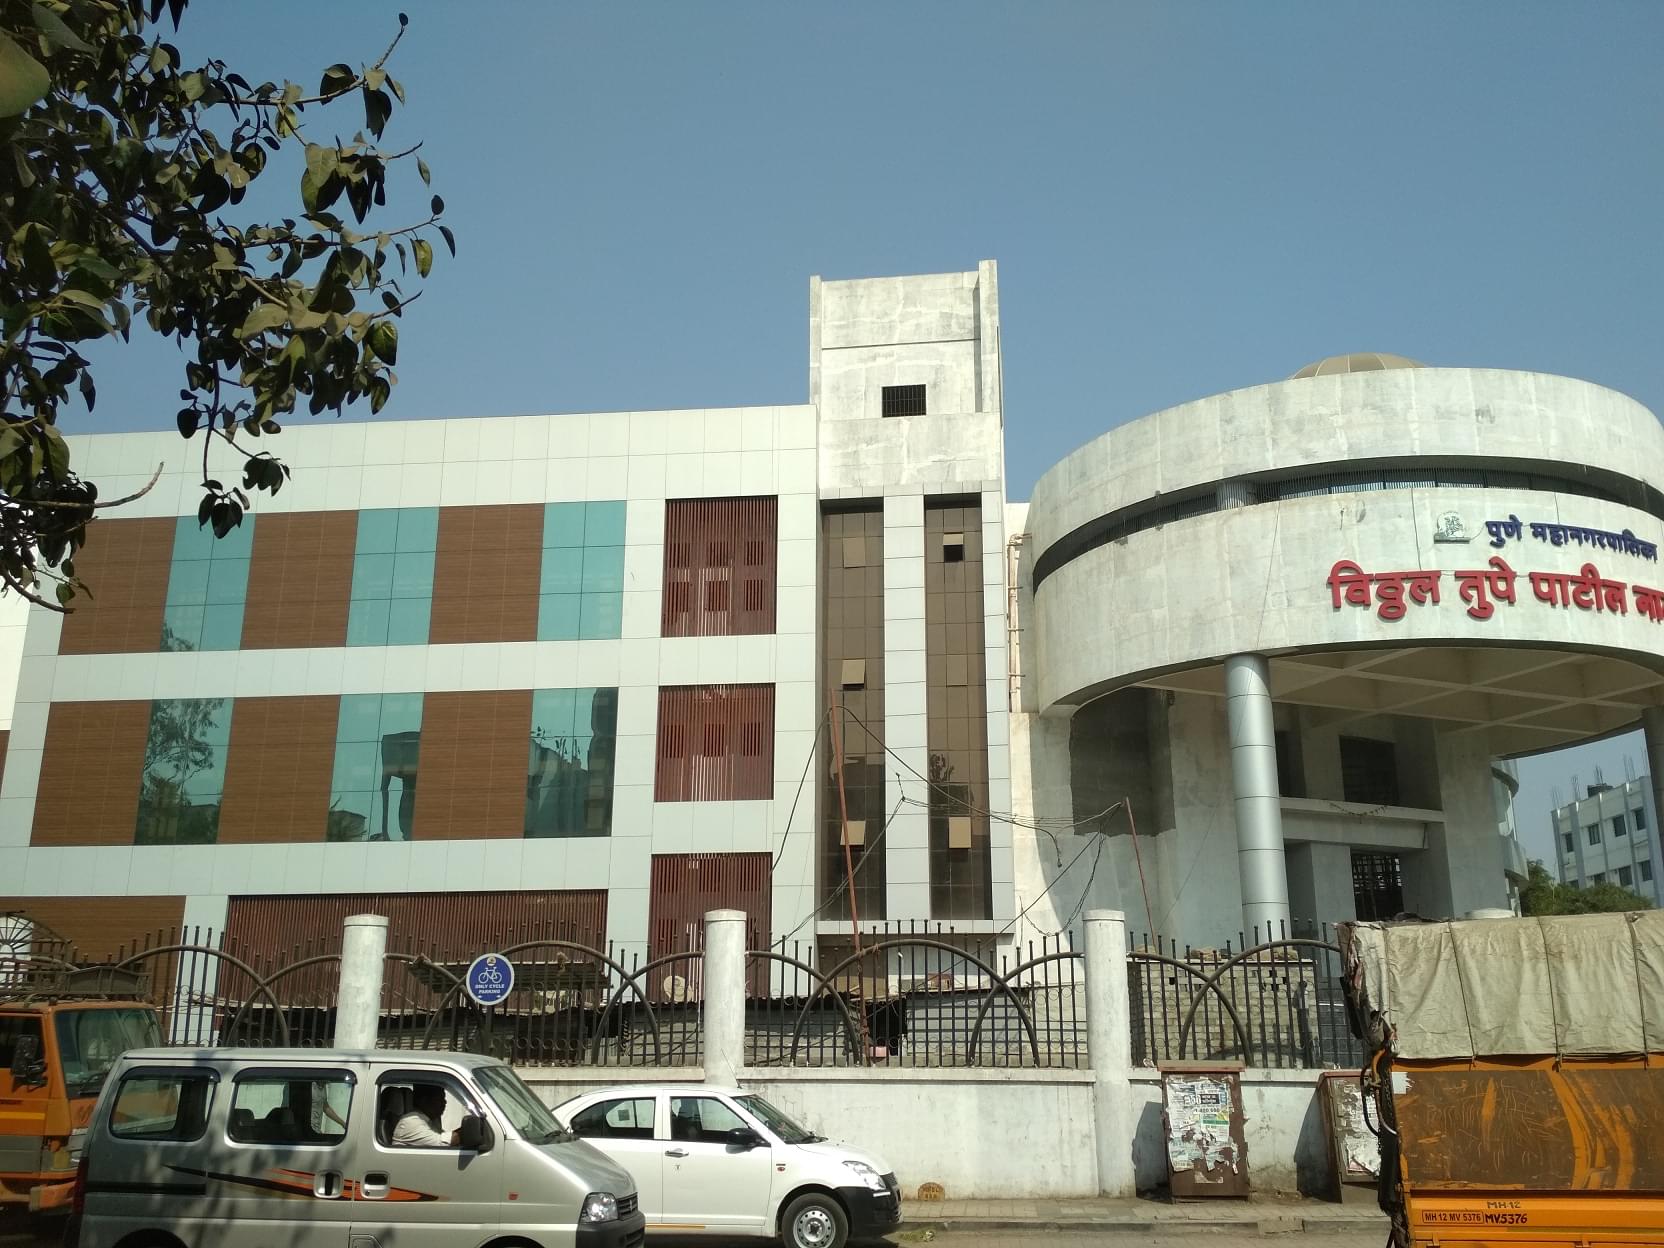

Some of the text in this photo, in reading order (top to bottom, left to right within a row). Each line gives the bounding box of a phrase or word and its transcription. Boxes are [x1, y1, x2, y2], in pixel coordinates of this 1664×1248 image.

[1485, 514, 1658, 563] पुणे महानगरपालिका
[1454, 556, 1518, 619] तुपे
[1529, 563, 1627, 615] पाटील
[1425, 1212, 1481, 1222] MH 12 MV 5376
